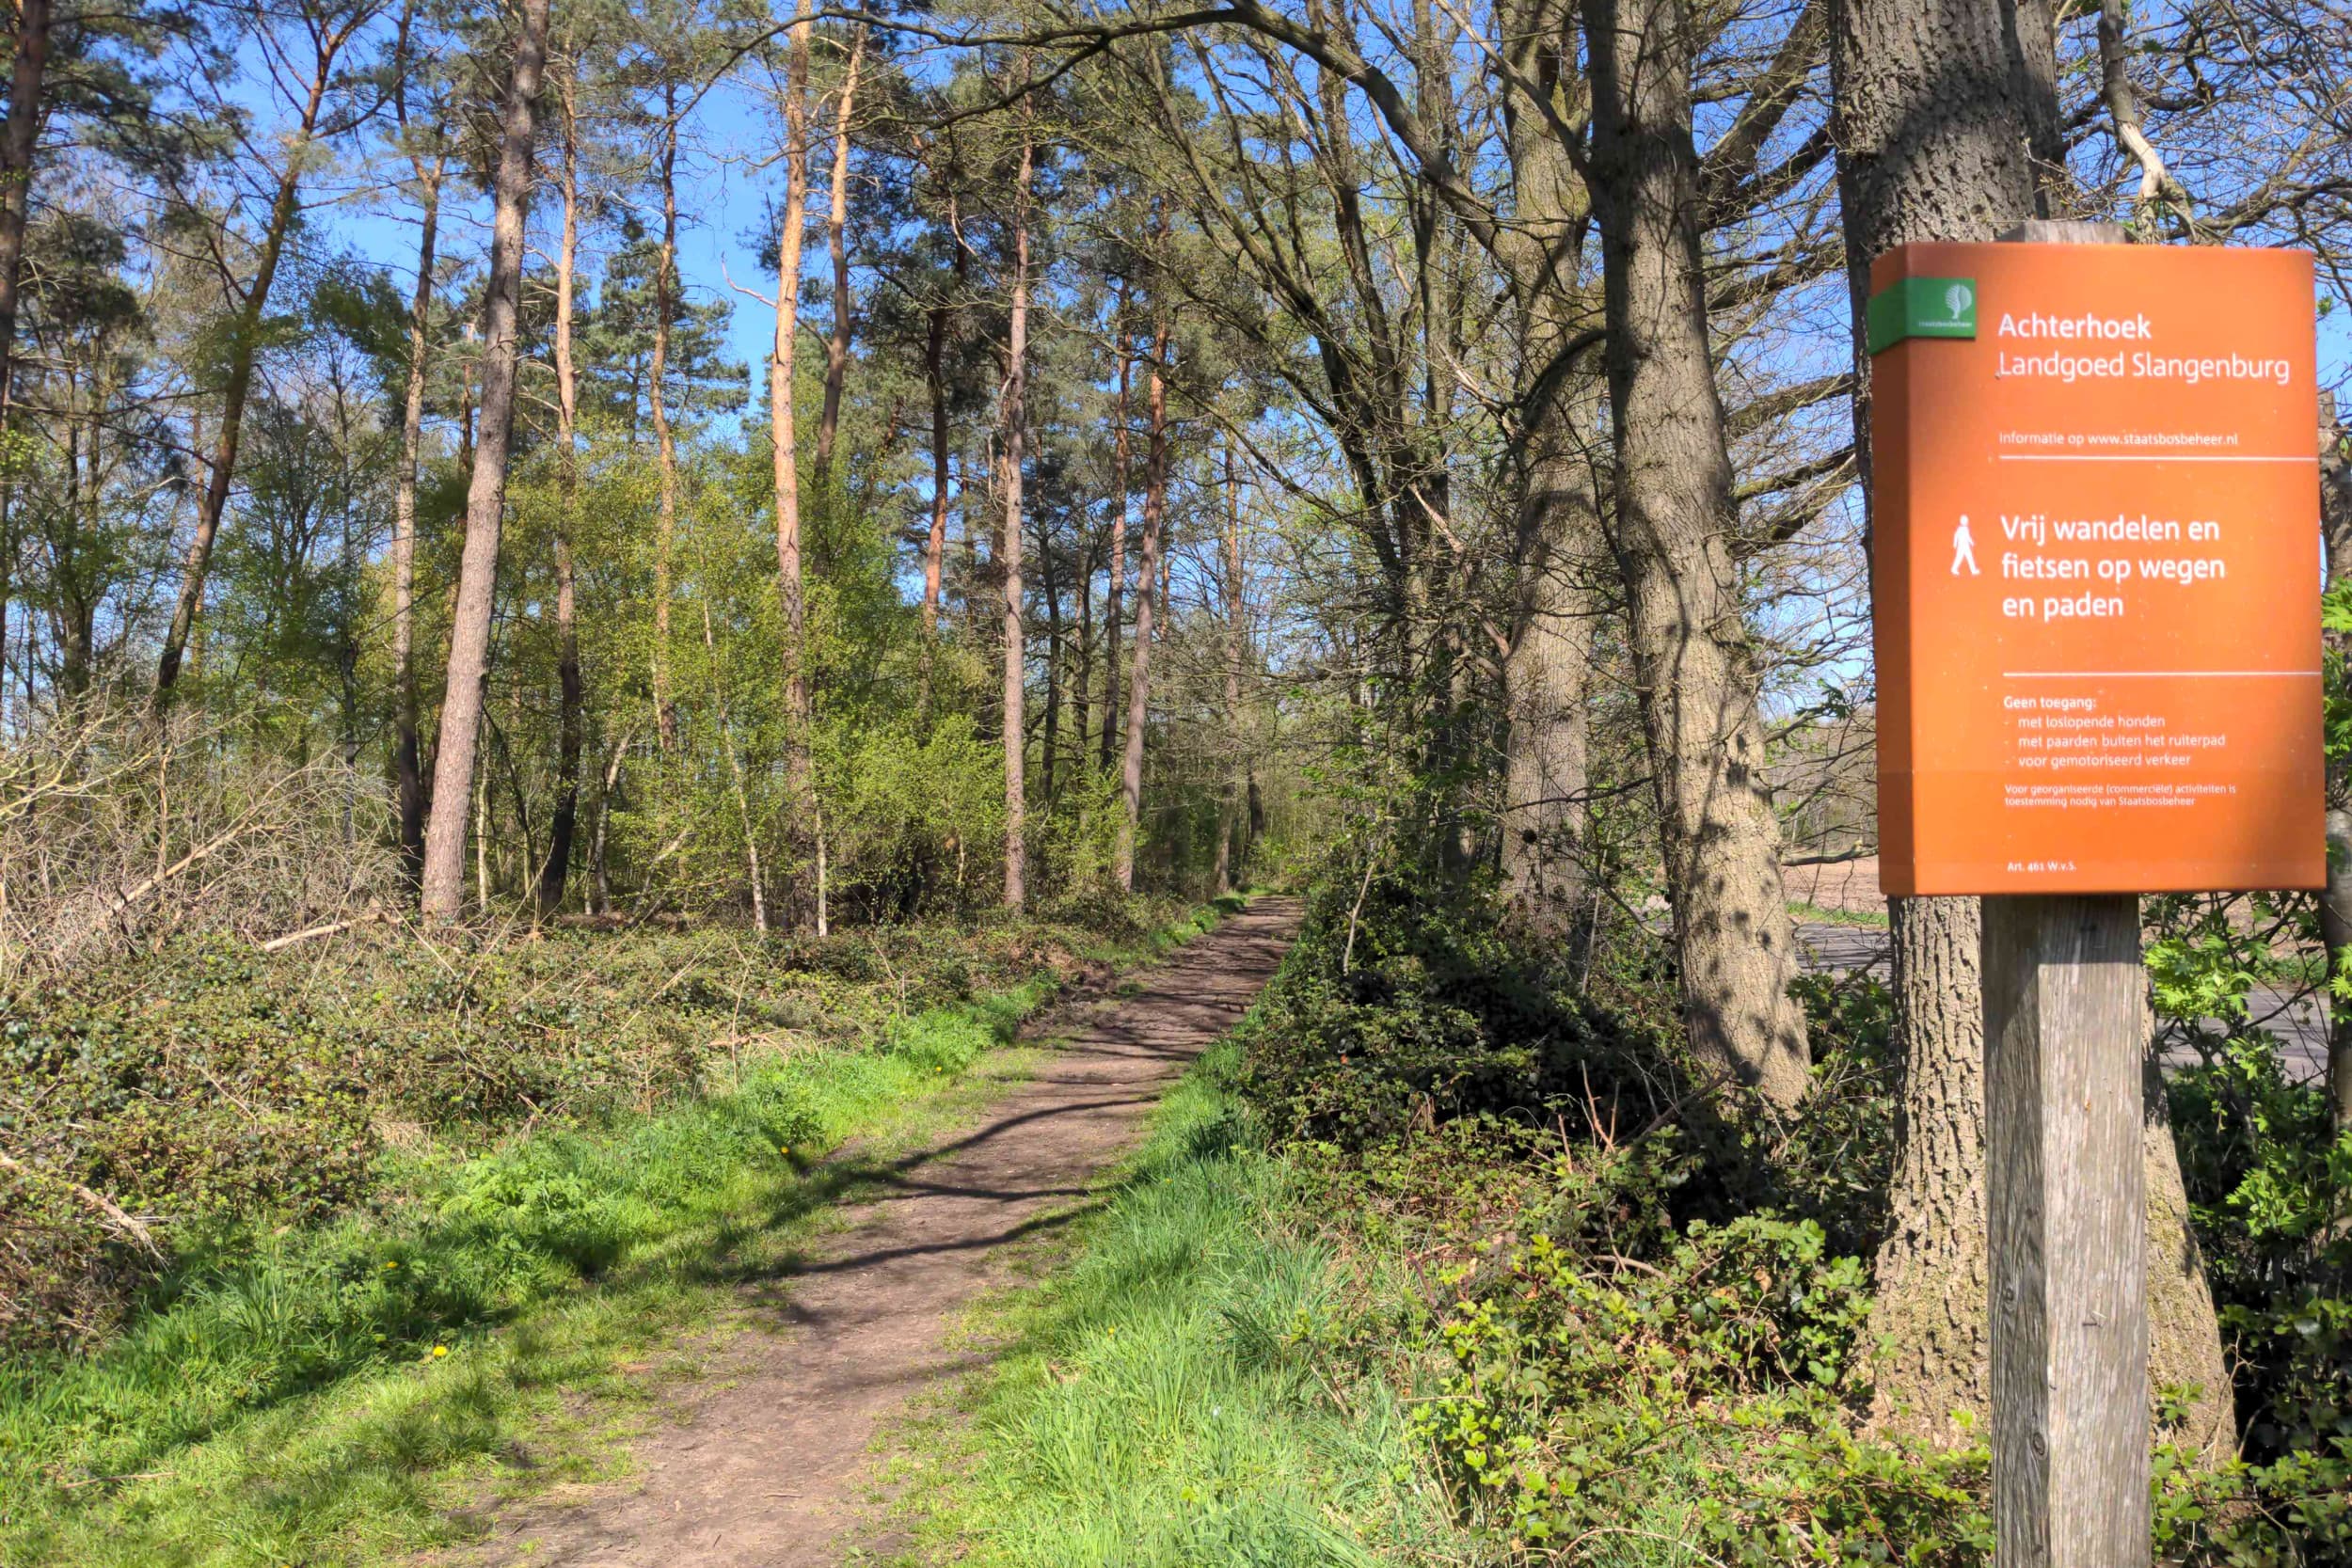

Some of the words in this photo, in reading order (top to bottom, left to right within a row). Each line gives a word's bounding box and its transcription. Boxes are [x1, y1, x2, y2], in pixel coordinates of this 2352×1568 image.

[1998, 312, 2152, 340] Achterhoek
[1998, 351, 2124, 383] Landgoed
[2132, 352, 2290, 386] Slangenburg
[1999, 431, 2065, 445] Informatie
[2068, 434, 2084, 447] op
[2087, 432, 2238, 447] www.staatsbosbeheer.nl
[2001, 515, 2045, 546] Vrij
[2054, 515, 2180, 541] wandelen
[2187, 520, 2220, 542] en
[2002, 553, 2090, 578] fietsen
[2097, 559, 2132, 584] op
[2137, 559, 2226, 586] wegen
[2002, 596, 2035, 618] en
[2043, 592, 2123, 623] paden
[2003, 696, 2037, 709] Geen
[2040, 697, 2097, 712] toegang:
[2018, 717, 2042, 728] met
[2046, 716, 2115, 731] loslopende
[2118, 715, 2166, 728] honden
[2018, 737, 2042, 748] met
[2046, 736, 2097, 750] paarden
[2102, 736, 2142, 747] buiten
[2145, 734, 2165, 747] het
[2169, 734, 2226, 749] ruiterpad
[2018, 756, 2047, 768] voor
[2051, 753, 2142, 770] gemotoriseerd
[2145, 753, 2191, 766] verkeer
[2004, 784, 2028, 795] Voor
[2030, 784, 2104, 798] georganiseerde
[2106, 784, 2173, 796] (commerciële)
[2175, 784, 2227, 795] activiteiten
[2228, 784, 2236, 795] is
[2004, 797, 2068, 809] toestemming
[2069, 797, 2098, 809] nodig
[2099, 798, 2117, 807] van
[2119, 795, 2196, 807] Staatsbosbeheer
[2007, 862, 2026, 873] Art.
